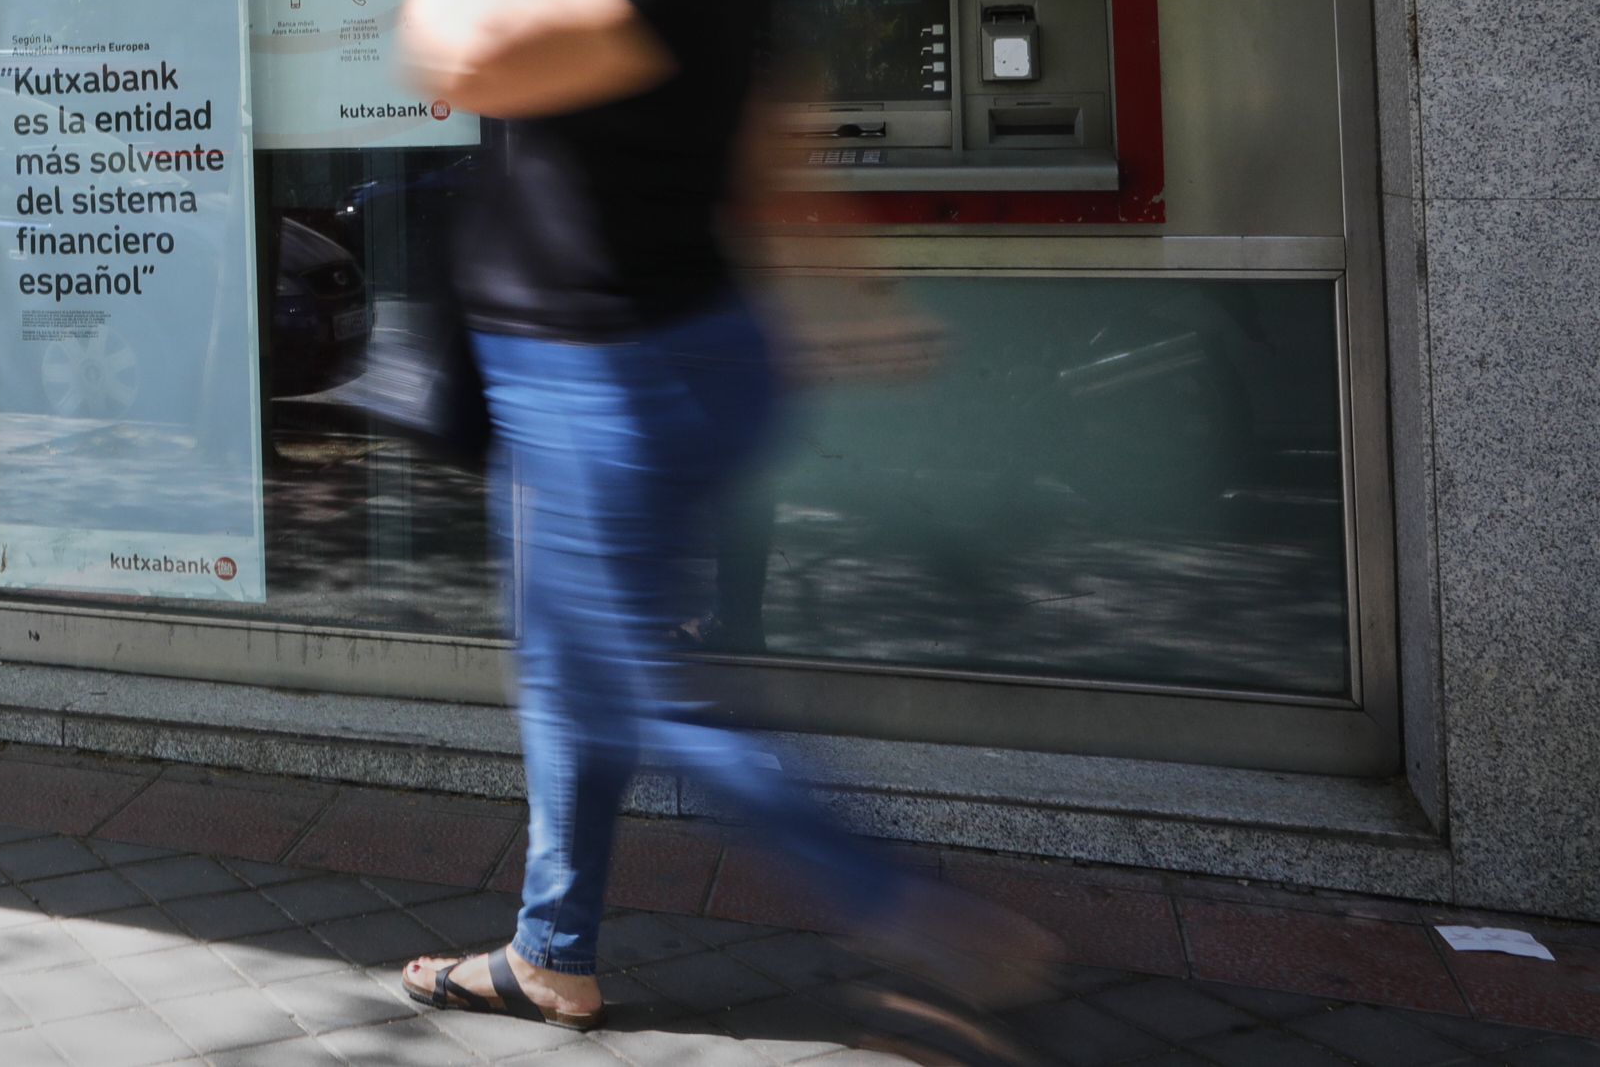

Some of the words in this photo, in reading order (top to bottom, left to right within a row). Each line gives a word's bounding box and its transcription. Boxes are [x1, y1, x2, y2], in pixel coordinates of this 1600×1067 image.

[12, 34, 41, 46] Según
[43, 33, 52, 44] la
[288, 26, 320, 34] Kutxabank
[61, 43, 106, 55] Bancaria
[109, 42, 150, 54] Europea
[13, 113, 49, 135] es
[58, 105, 86, 134] la
[94, 99, 212, 133] entidad
[340, 102, 428, 118] kutxabank
[15, 144, 81, 175] más
[90, 143, 225, 174] solvente
[16, 185, 64, 216] del
[72, 185, 198, 215] sistema
[16, 224, 175, 255] financiero
[110, 552, 211, 575] kutxabank
